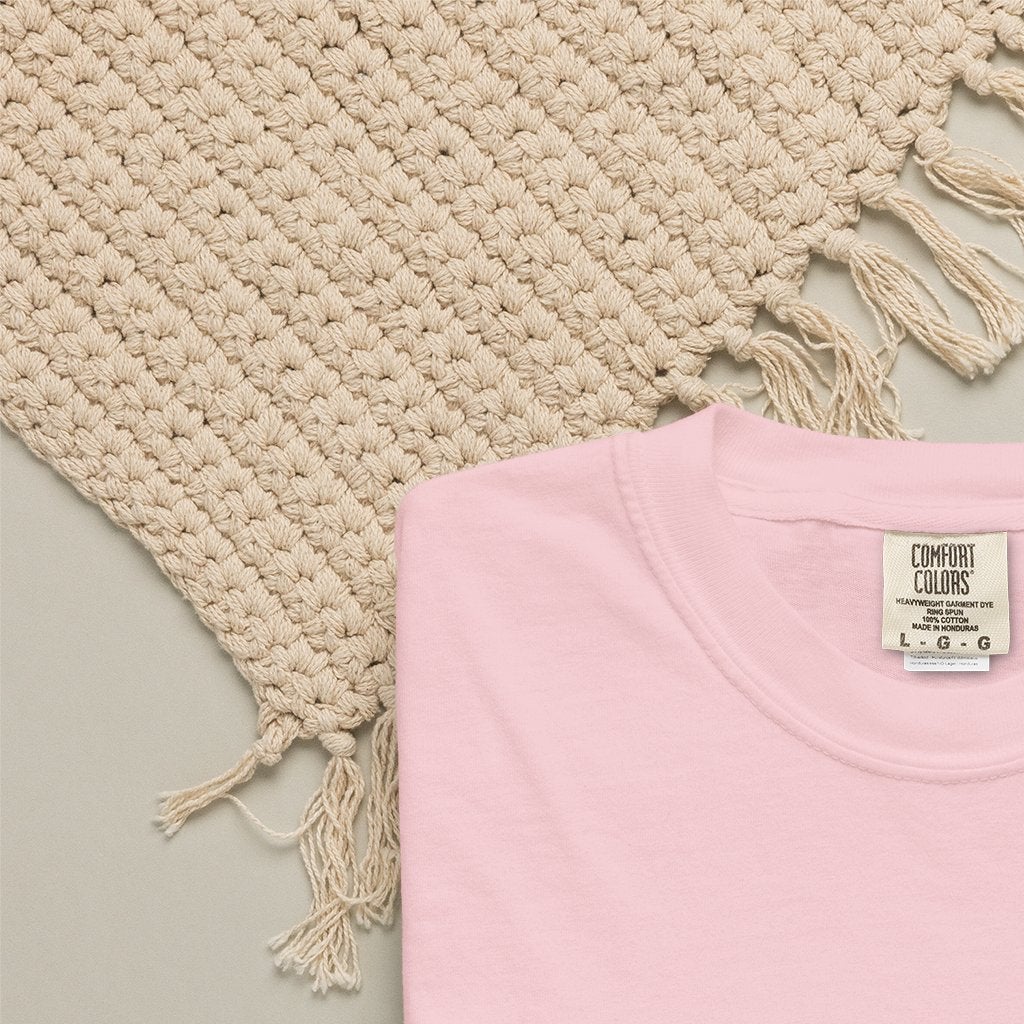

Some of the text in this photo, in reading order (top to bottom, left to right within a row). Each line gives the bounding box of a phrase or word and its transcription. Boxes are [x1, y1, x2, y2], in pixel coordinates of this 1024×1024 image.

[911, 543, 976, 568] COMFORT
[895, 597, 994, 609] HEAVYWEIGHT GARMENT DYE
[926, 608, 964, 616] RING SPUN
[922, 616, 969, 624] 100% COTTON
[911, 622, 979, 632] MADE IN HONDURAS
[900, 632, 910, 647] L
[937, 635, 950, 650] G
[977, 635, 991, 650] G
